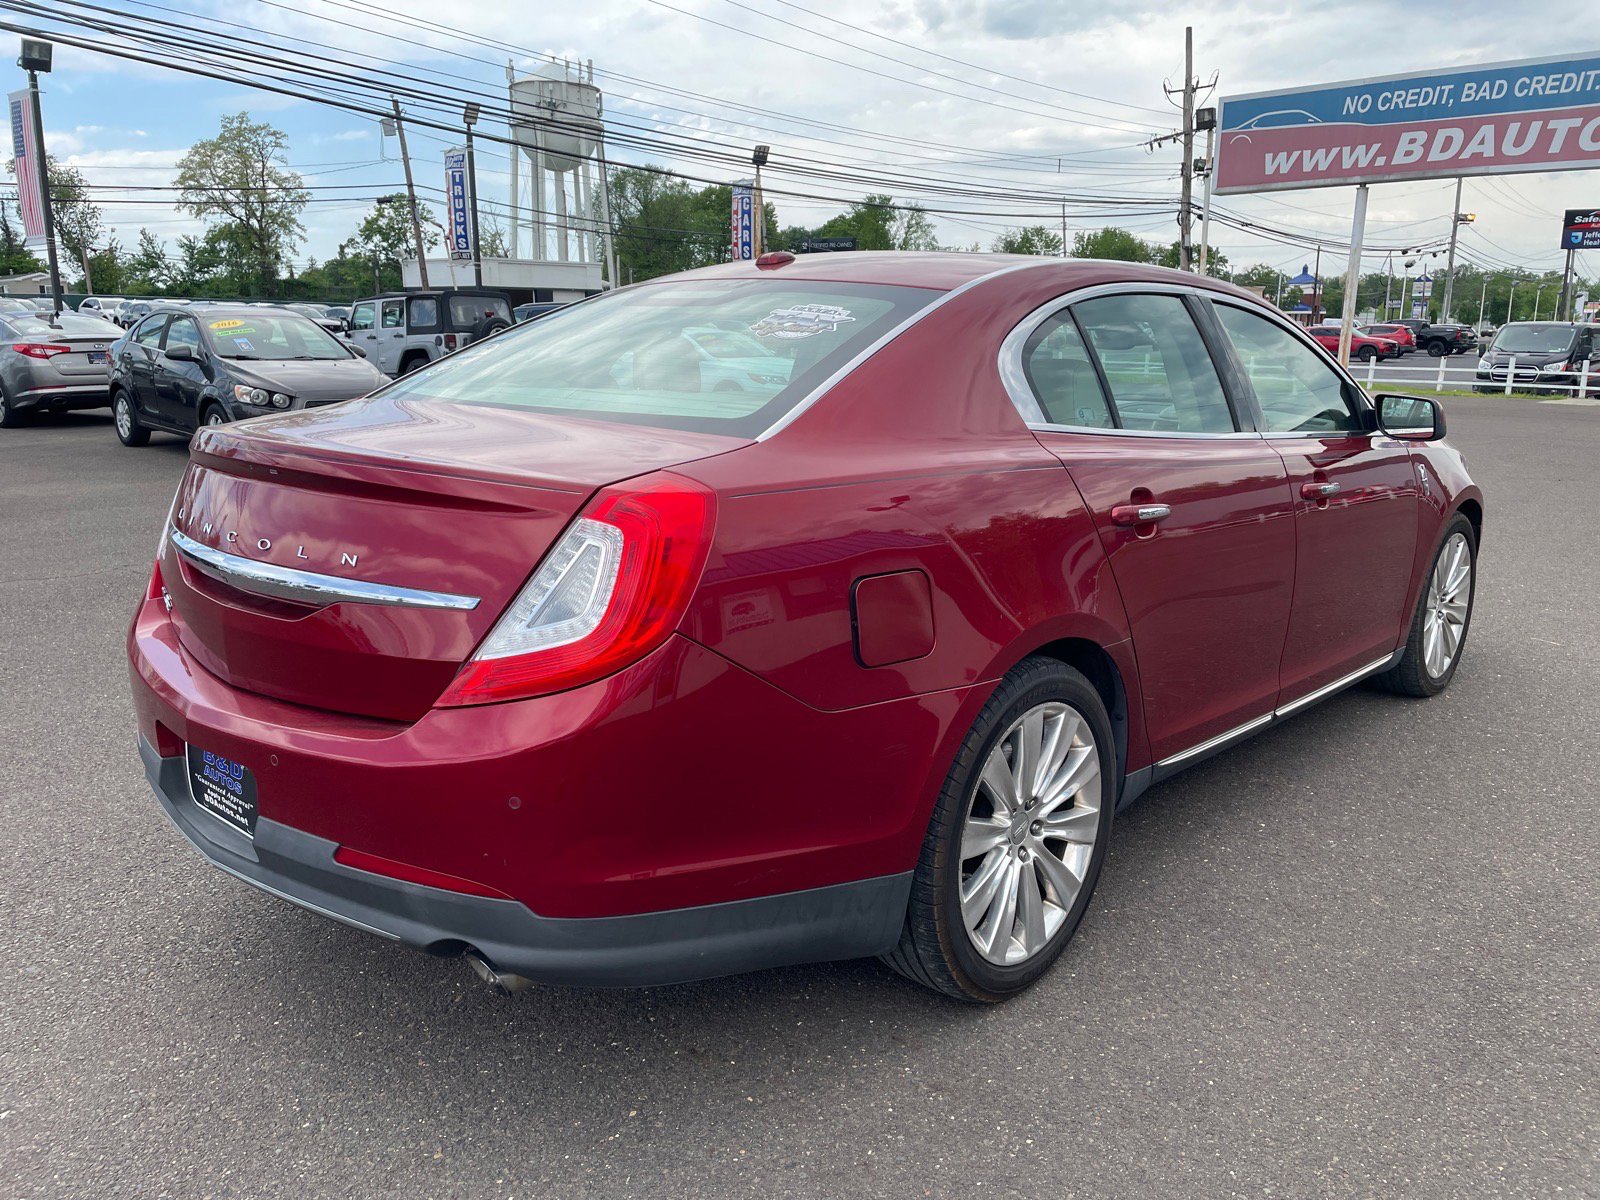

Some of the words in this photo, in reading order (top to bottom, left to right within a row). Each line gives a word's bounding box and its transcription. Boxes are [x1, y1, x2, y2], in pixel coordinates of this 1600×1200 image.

[1342, 94, 1372, 115] NO
[1377, 85, 1454, 111] CREDIT,
[1461, 79, 1508, 102] BAD
[453, 172, 467, 249] TRUCKS
[742, 197, 750, 258] CARS
[1574, 215, 1600, 223] Safe
[178, 507, 358, 568] LINCOLN
[203, 764, 243, 795] AUTOS
[204, 793, 249, 827] BDAutos.net
